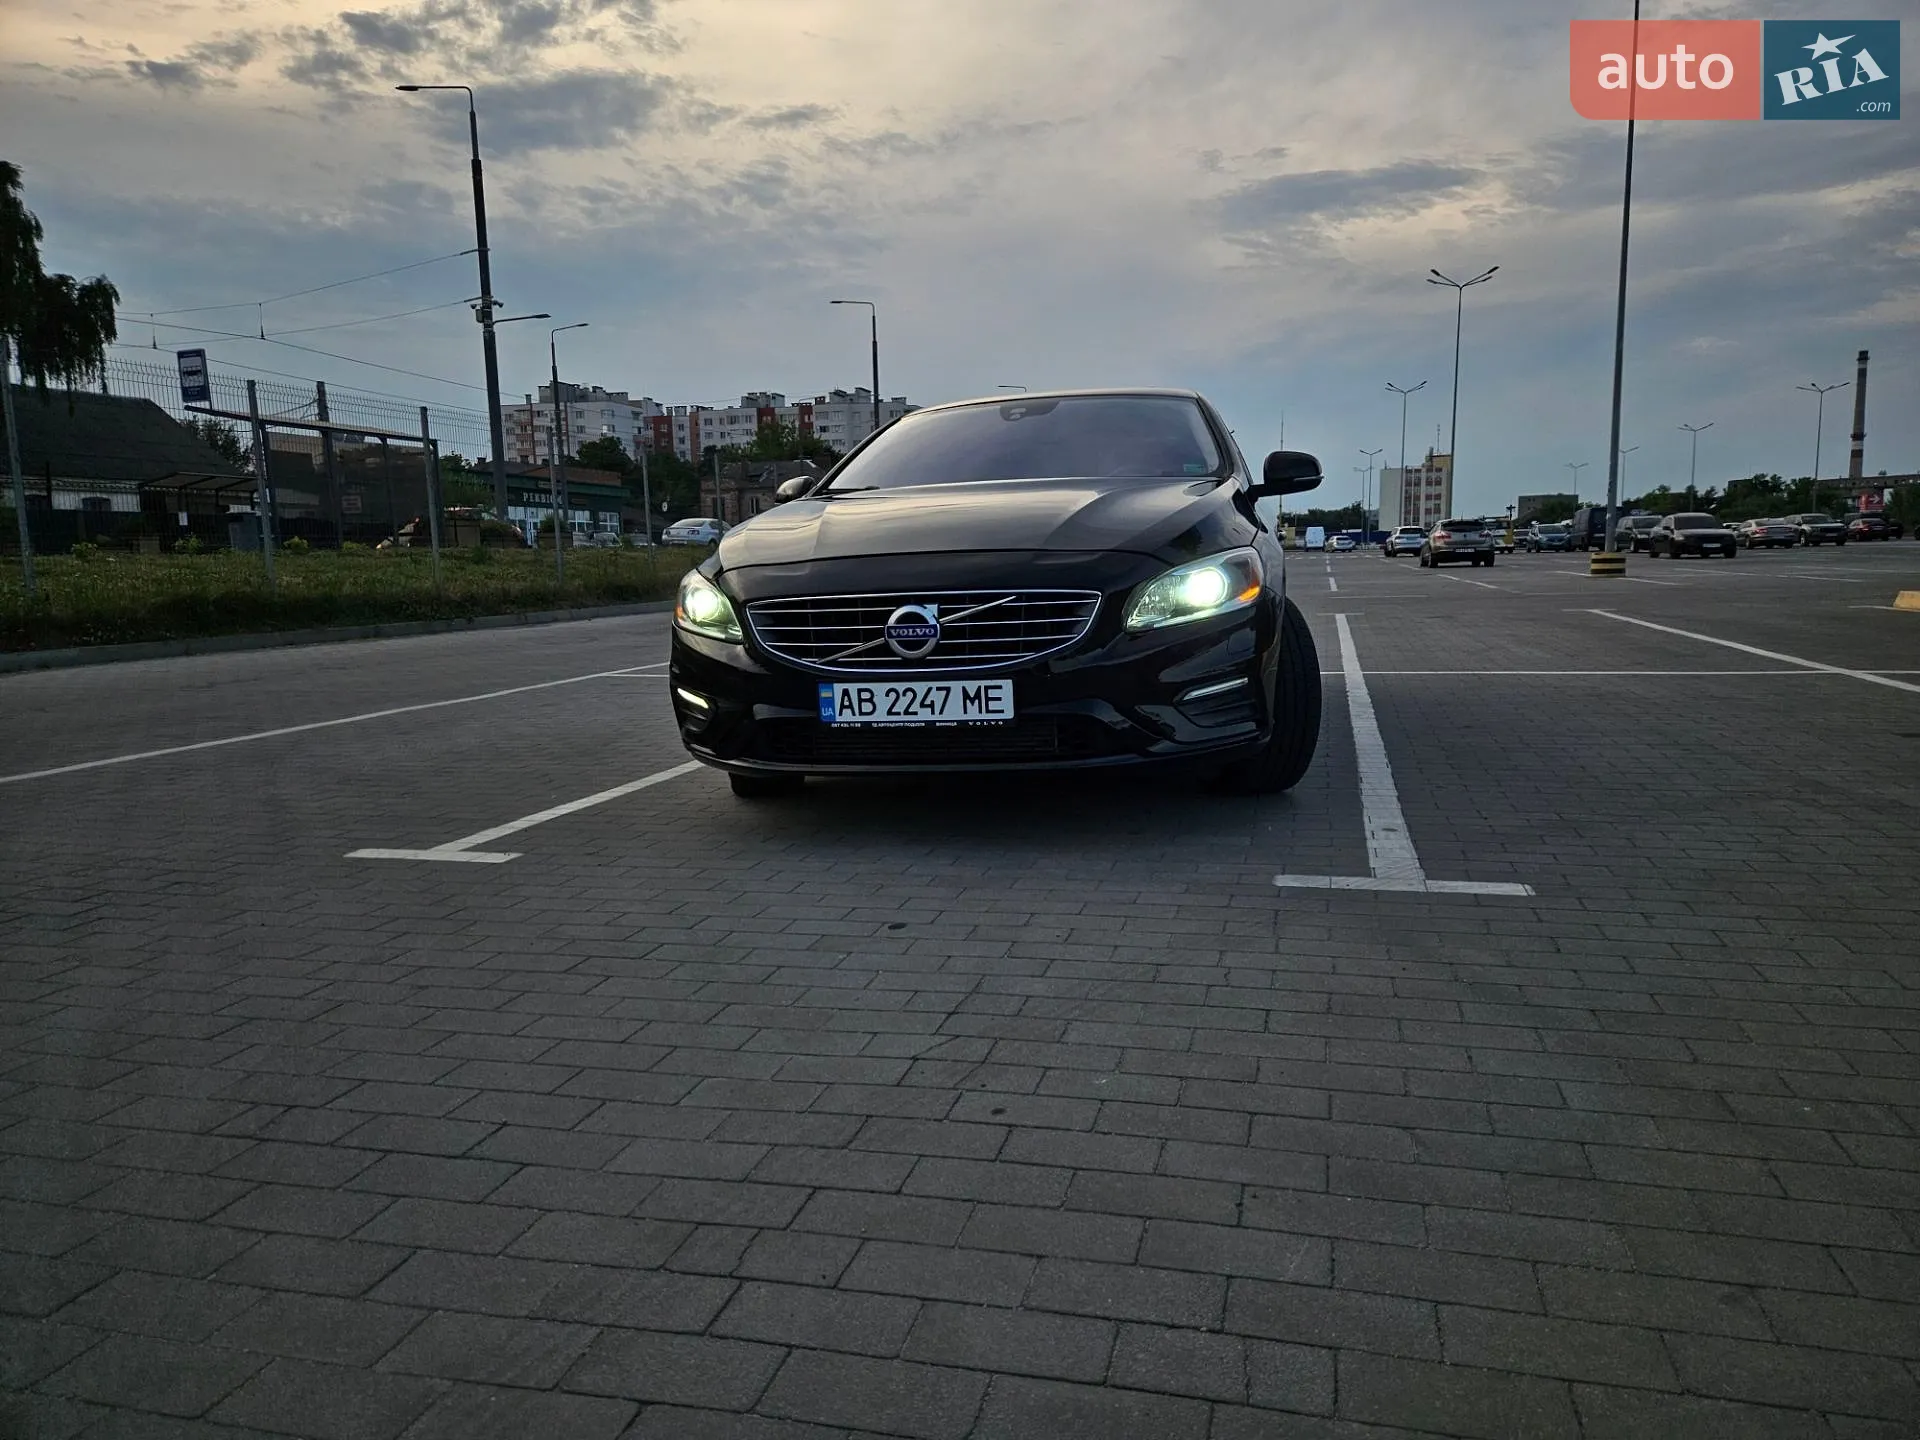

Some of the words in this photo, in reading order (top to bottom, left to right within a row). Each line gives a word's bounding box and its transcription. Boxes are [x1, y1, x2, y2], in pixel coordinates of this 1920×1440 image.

[890, 628, 935, 637] VOLVO
[838, 687, 877, 717] AB
[885, 686, 951, 716] 2247
[962, 684, 1005, 715] ME
[821, 707, 834, 716] UA
